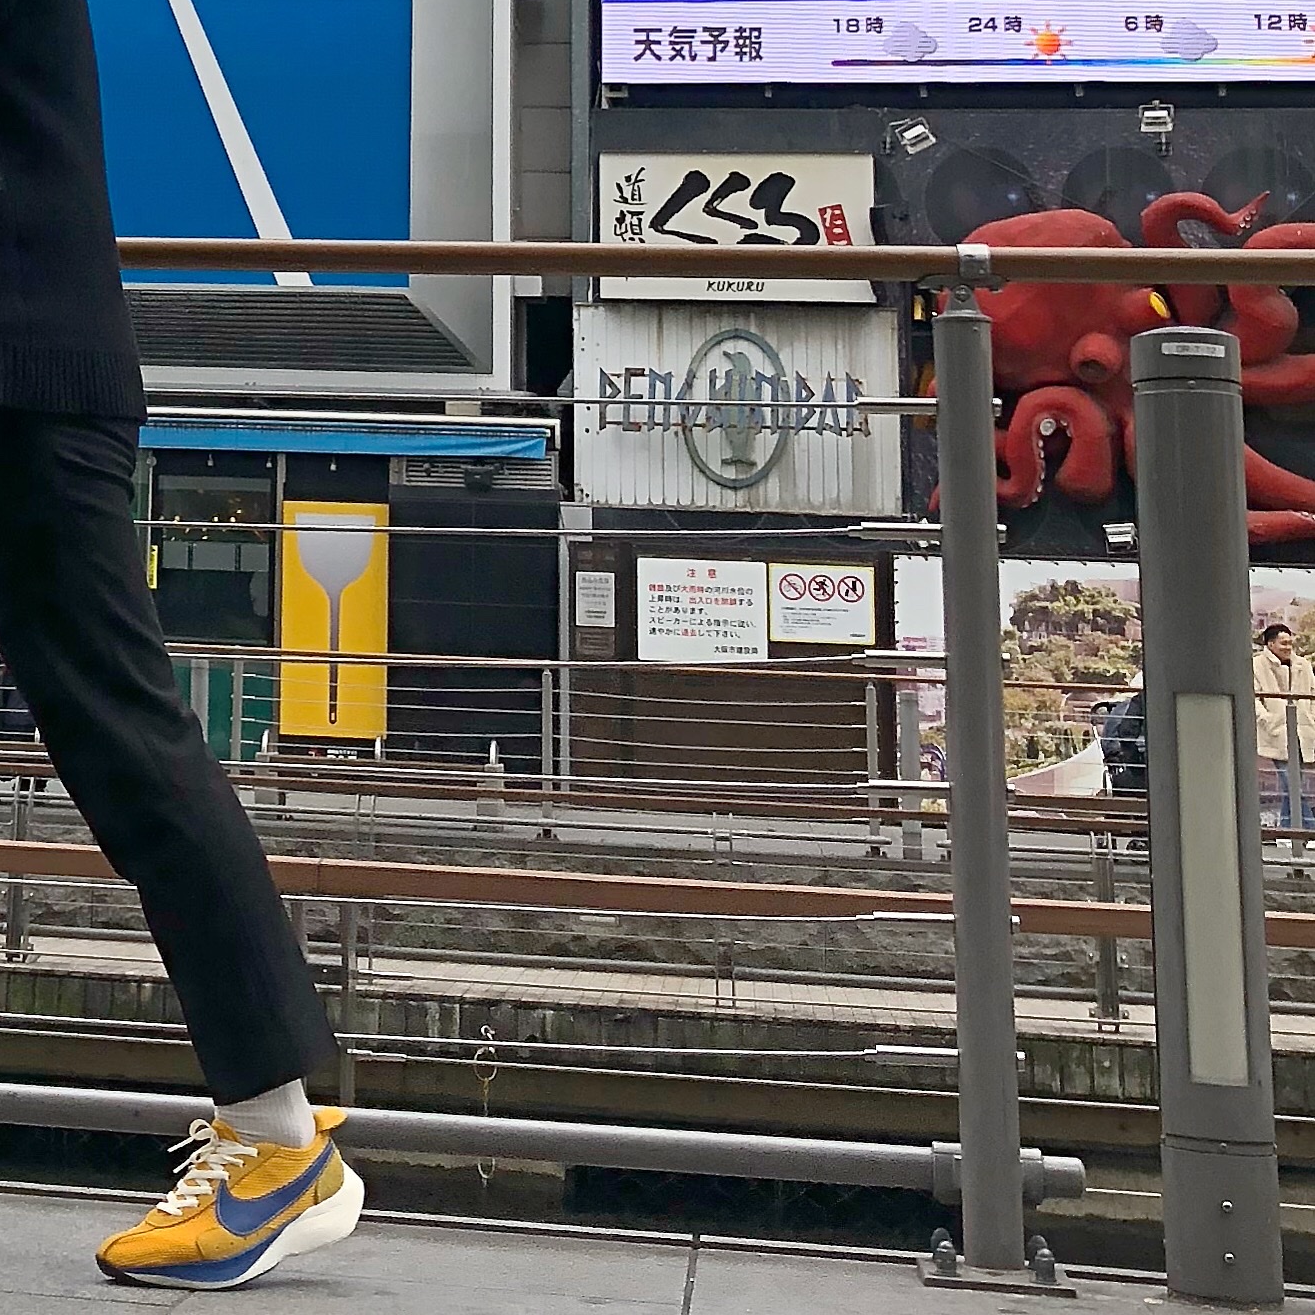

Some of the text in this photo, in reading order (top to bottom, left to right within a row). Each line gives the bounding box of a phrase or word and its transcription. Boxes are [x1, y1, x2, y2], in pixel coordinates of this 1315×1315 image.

[632, 26, 764, 63] 天気予報
[706, 280, 765, 292] KUKURU
[794, 370, 871, 438] BAR
